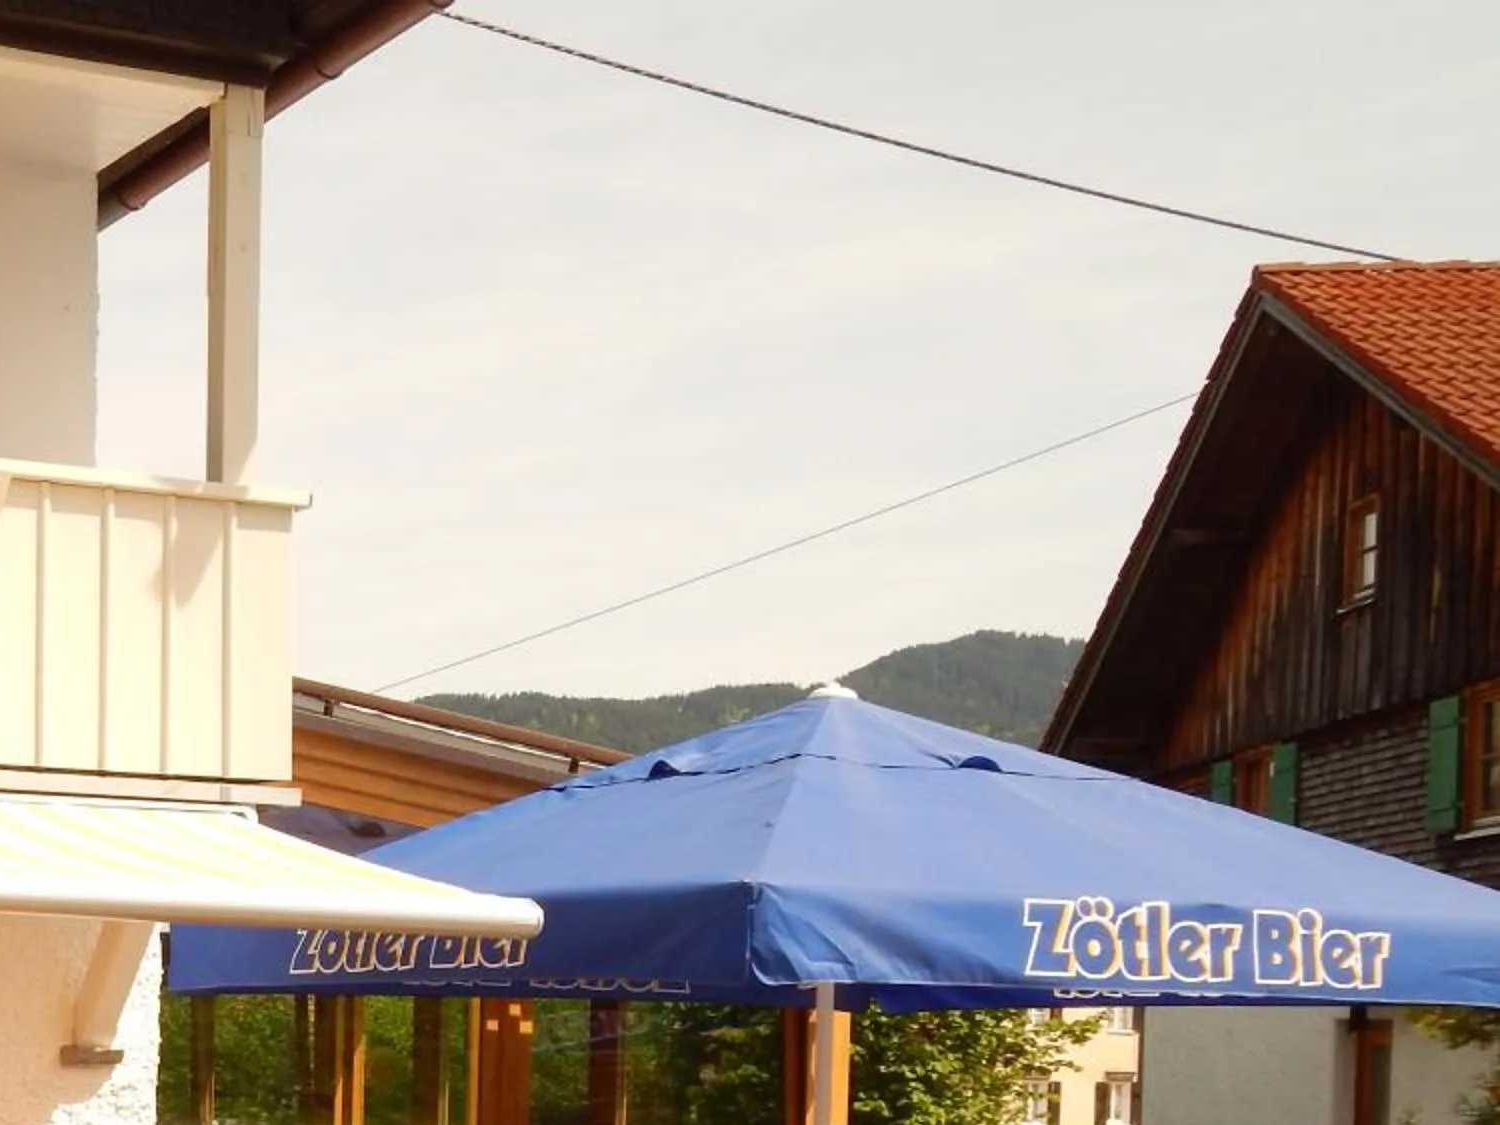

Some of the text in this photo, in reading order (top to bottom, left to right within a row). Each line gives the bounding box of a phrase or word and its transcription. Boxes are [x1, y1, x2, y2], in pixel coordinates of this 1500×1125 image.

[429, 934, 527, 969] Bier
[1023, 896, 1390, 988] Zötler Bier
